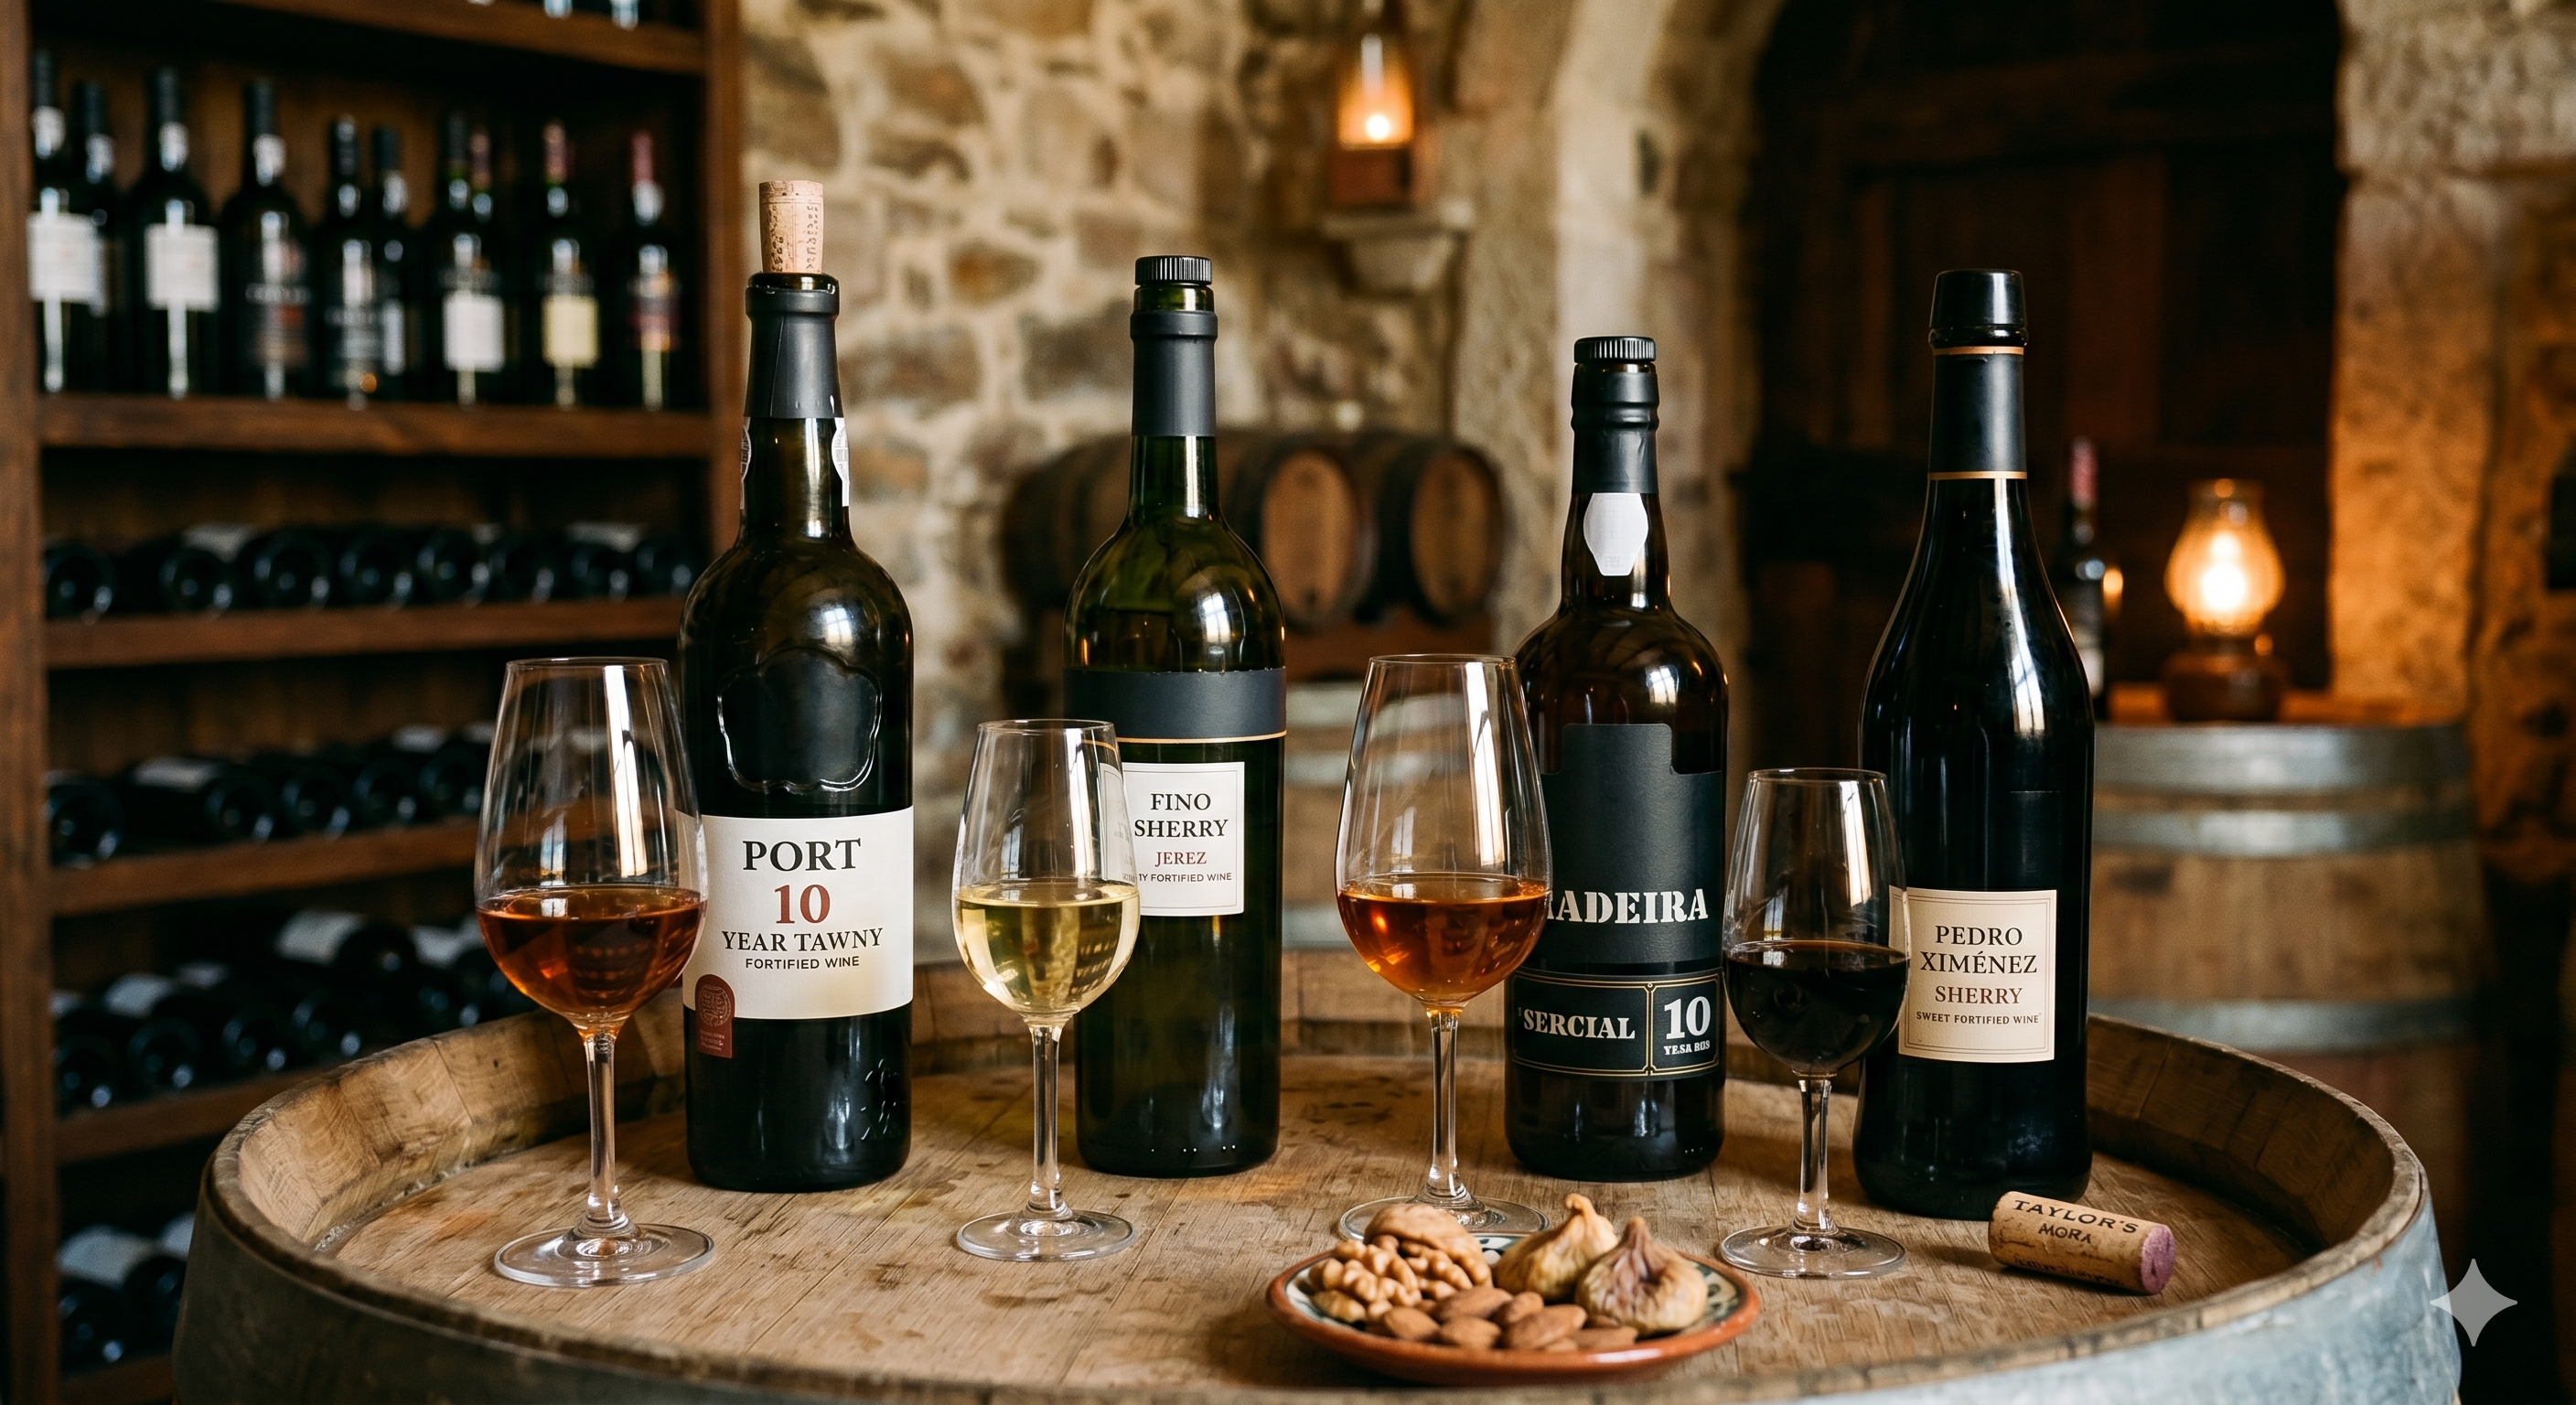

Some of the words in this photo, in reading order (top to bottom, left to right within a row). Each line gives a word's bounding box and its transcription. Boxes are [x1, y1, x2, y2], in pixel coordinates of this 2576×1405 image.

[1150, 793, 1211, 810] FINO
[1134, 819, 1229, 838] SHERRY
[742, 838, 861, 872] PORT
[1154, 852, 1208, 867] JEREZ
[1151, 874, 1204, 883] FORTIFIED
[1207, 872, 1232, 882] WINE
[774, 884, 831, 924] 10
[721, 930, 788, 952] YEAR
[794, 928, 884, 952] TAWNY
[1935, 925, 2023, 946] PEDRO
[746, 958, 820, 970] FORTIFIED
[824, 956, 860, 968] WINE
[1920, 950, 2038, 974] XIMÉNEZ
[1935, 985, 2023, 1004] SHERRY
[1523, 1008, 1636, 1039] SERCIAL
[1664, 996, 1711, 1040] 10
[1916, 1011, 1950, 1023] SWEET
[1954, 1014, 2010, 1024] FORTIFIED
[2012, 1014, 2039, 1024] WINE
[2013, 1199, 2140, 1234] TAYLOR'S
[2037, 1222, 2092, 1244] MORA
